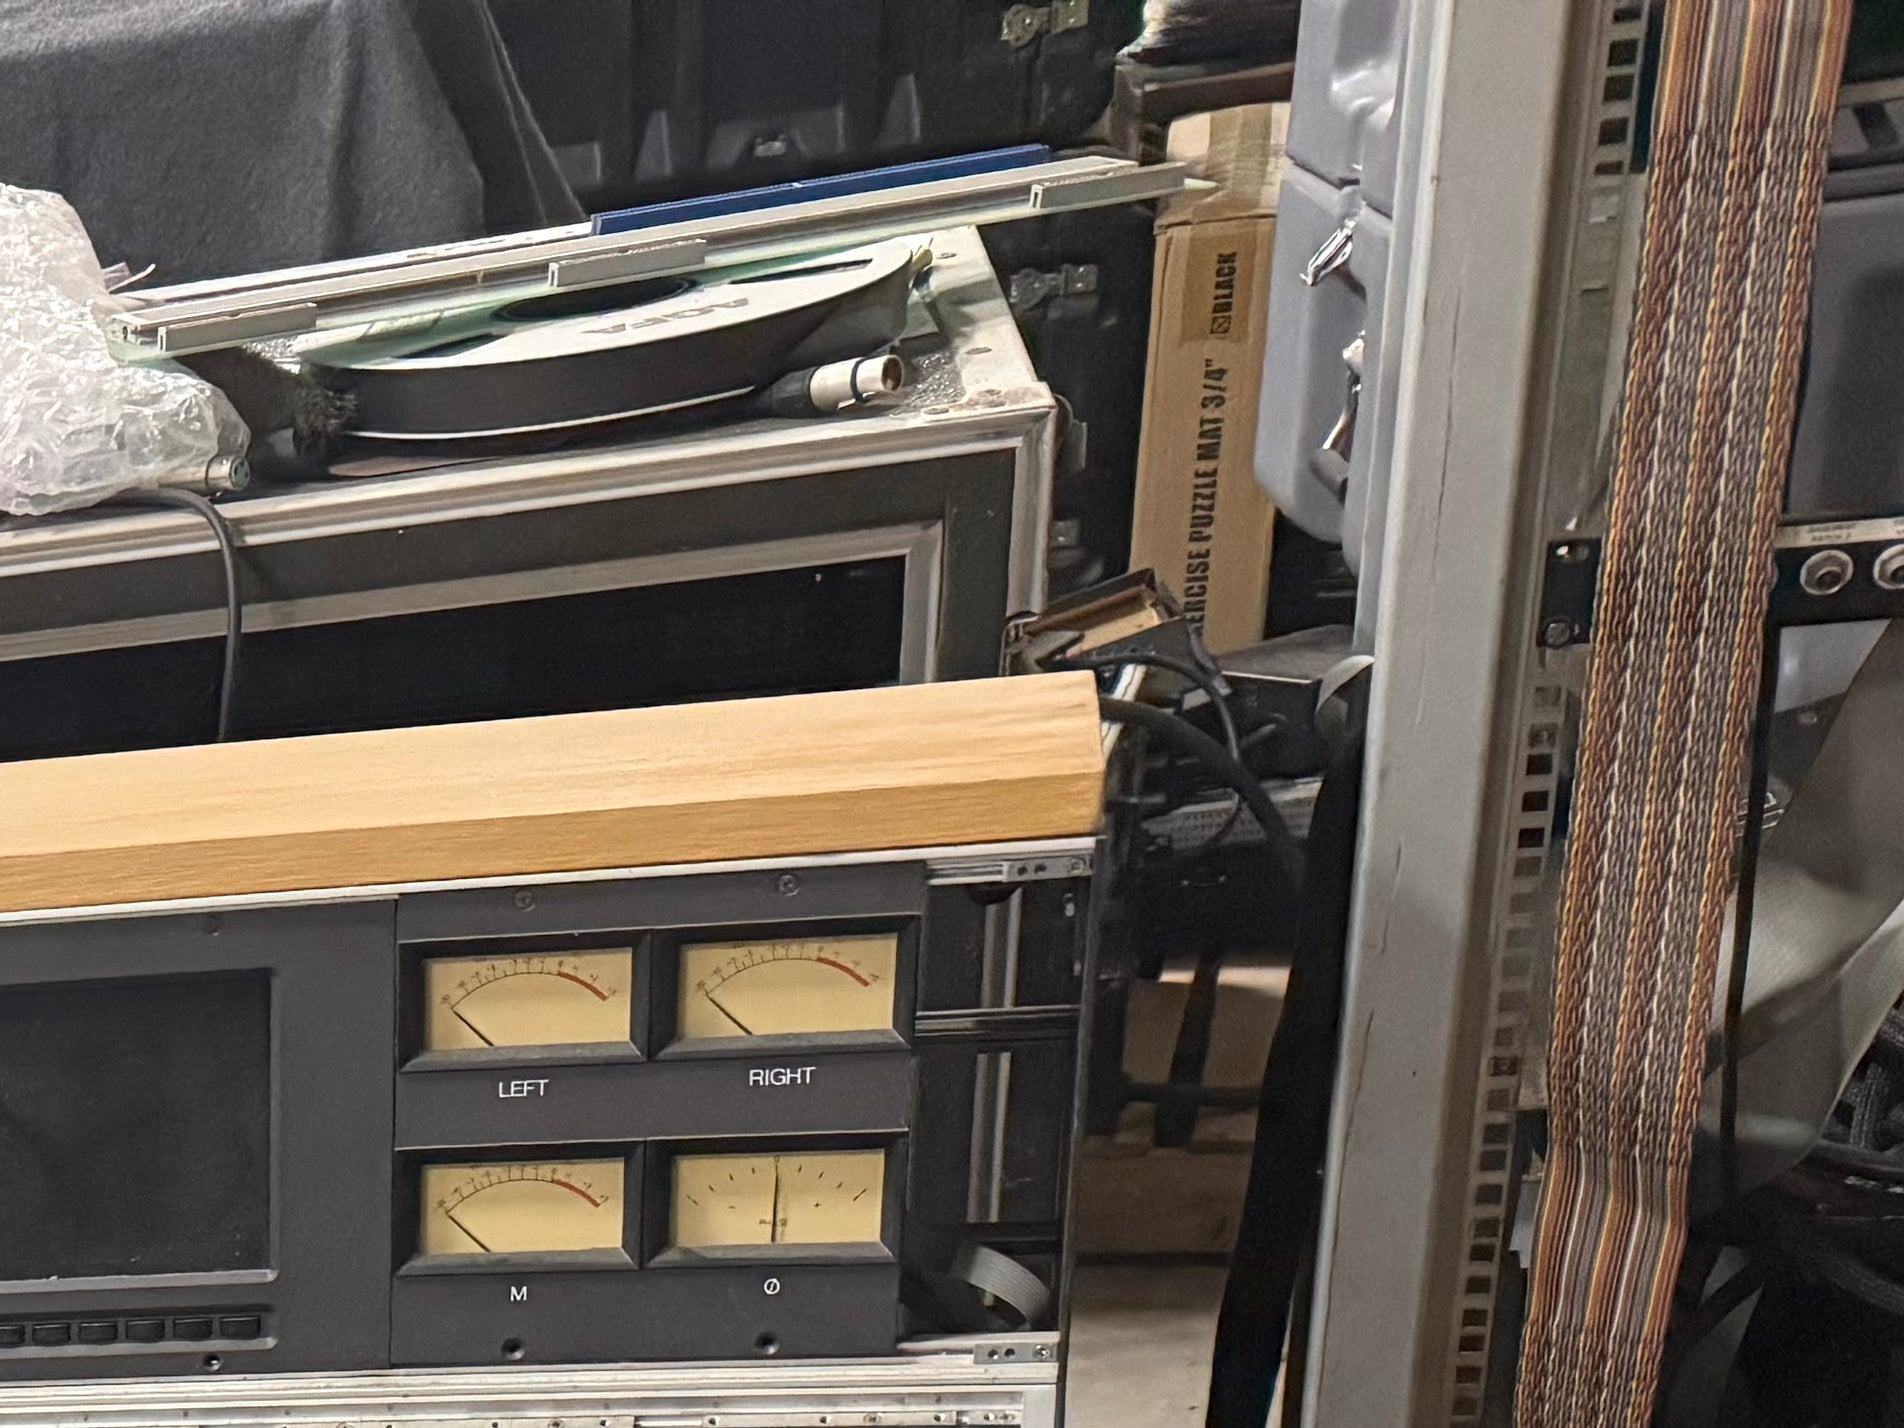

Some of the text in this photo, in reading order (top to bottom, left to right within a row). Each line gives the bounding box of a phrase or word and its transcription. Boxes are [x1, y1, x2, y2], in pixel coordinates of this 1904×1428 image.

[1212, 252, 1237, 314] BLACK
[1201, 358, 1228, 408] 3/4"
[1197, 418, 1224, 461] MAT
[1189, 467, 1218, 542] PUZZLE
[499, 1079, 549, 1099] LEFT
[749, 1067, 814, 1087] RIGHT
[510, 1286, 528, 1301] M
